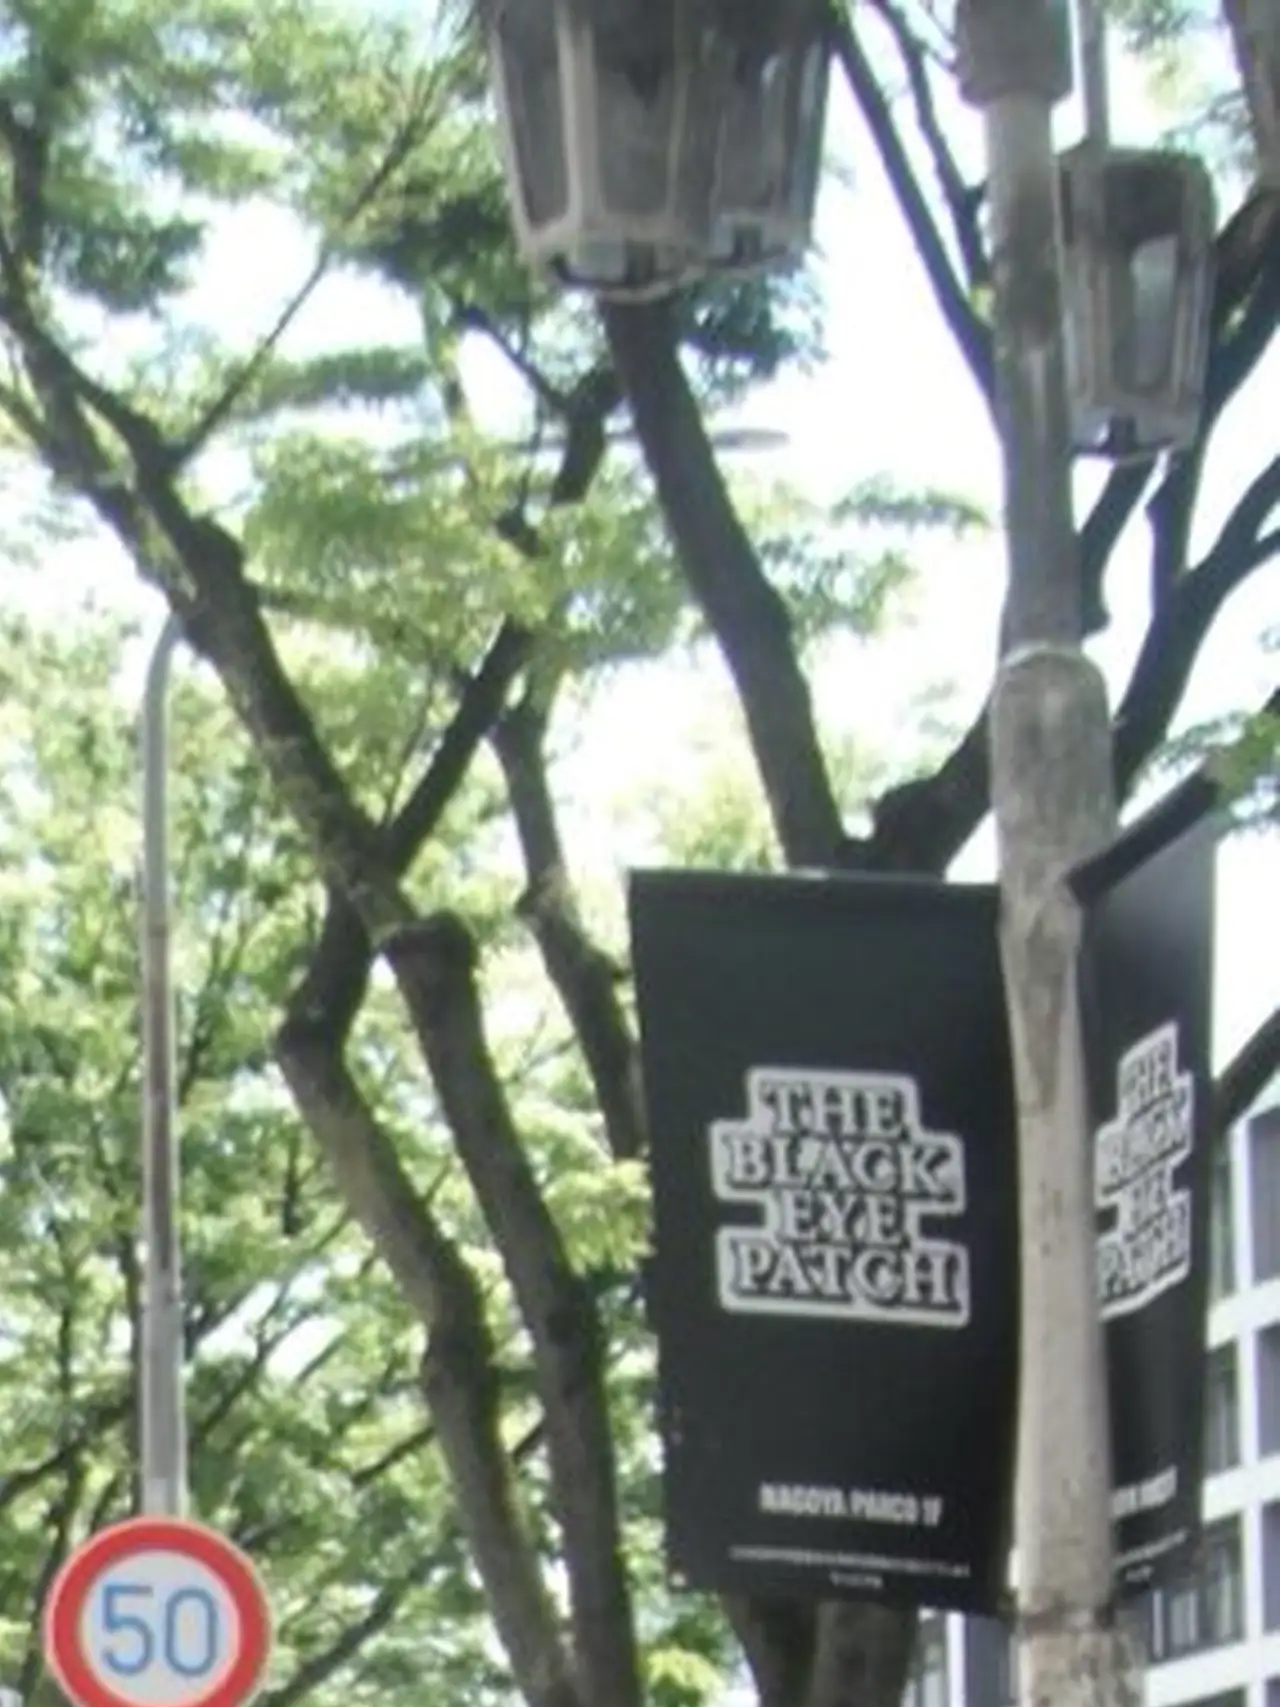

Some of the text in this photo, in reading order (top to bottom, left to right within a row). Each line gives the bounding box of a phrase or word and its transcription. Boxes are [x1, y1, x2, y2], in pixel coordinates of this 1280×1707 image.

[760, 1081, 906, 1137] THE
[727, 1133, 953, 1196] BLACK
[778, 1188, 906, 1245] EYE
[736, 1242, 957, 1307] PATCH
[759, 1482, 845, 1517] NAGOYA
[849, 1487, 919, 1525] PARCO
[102, 1584, 217, 1676] 50
